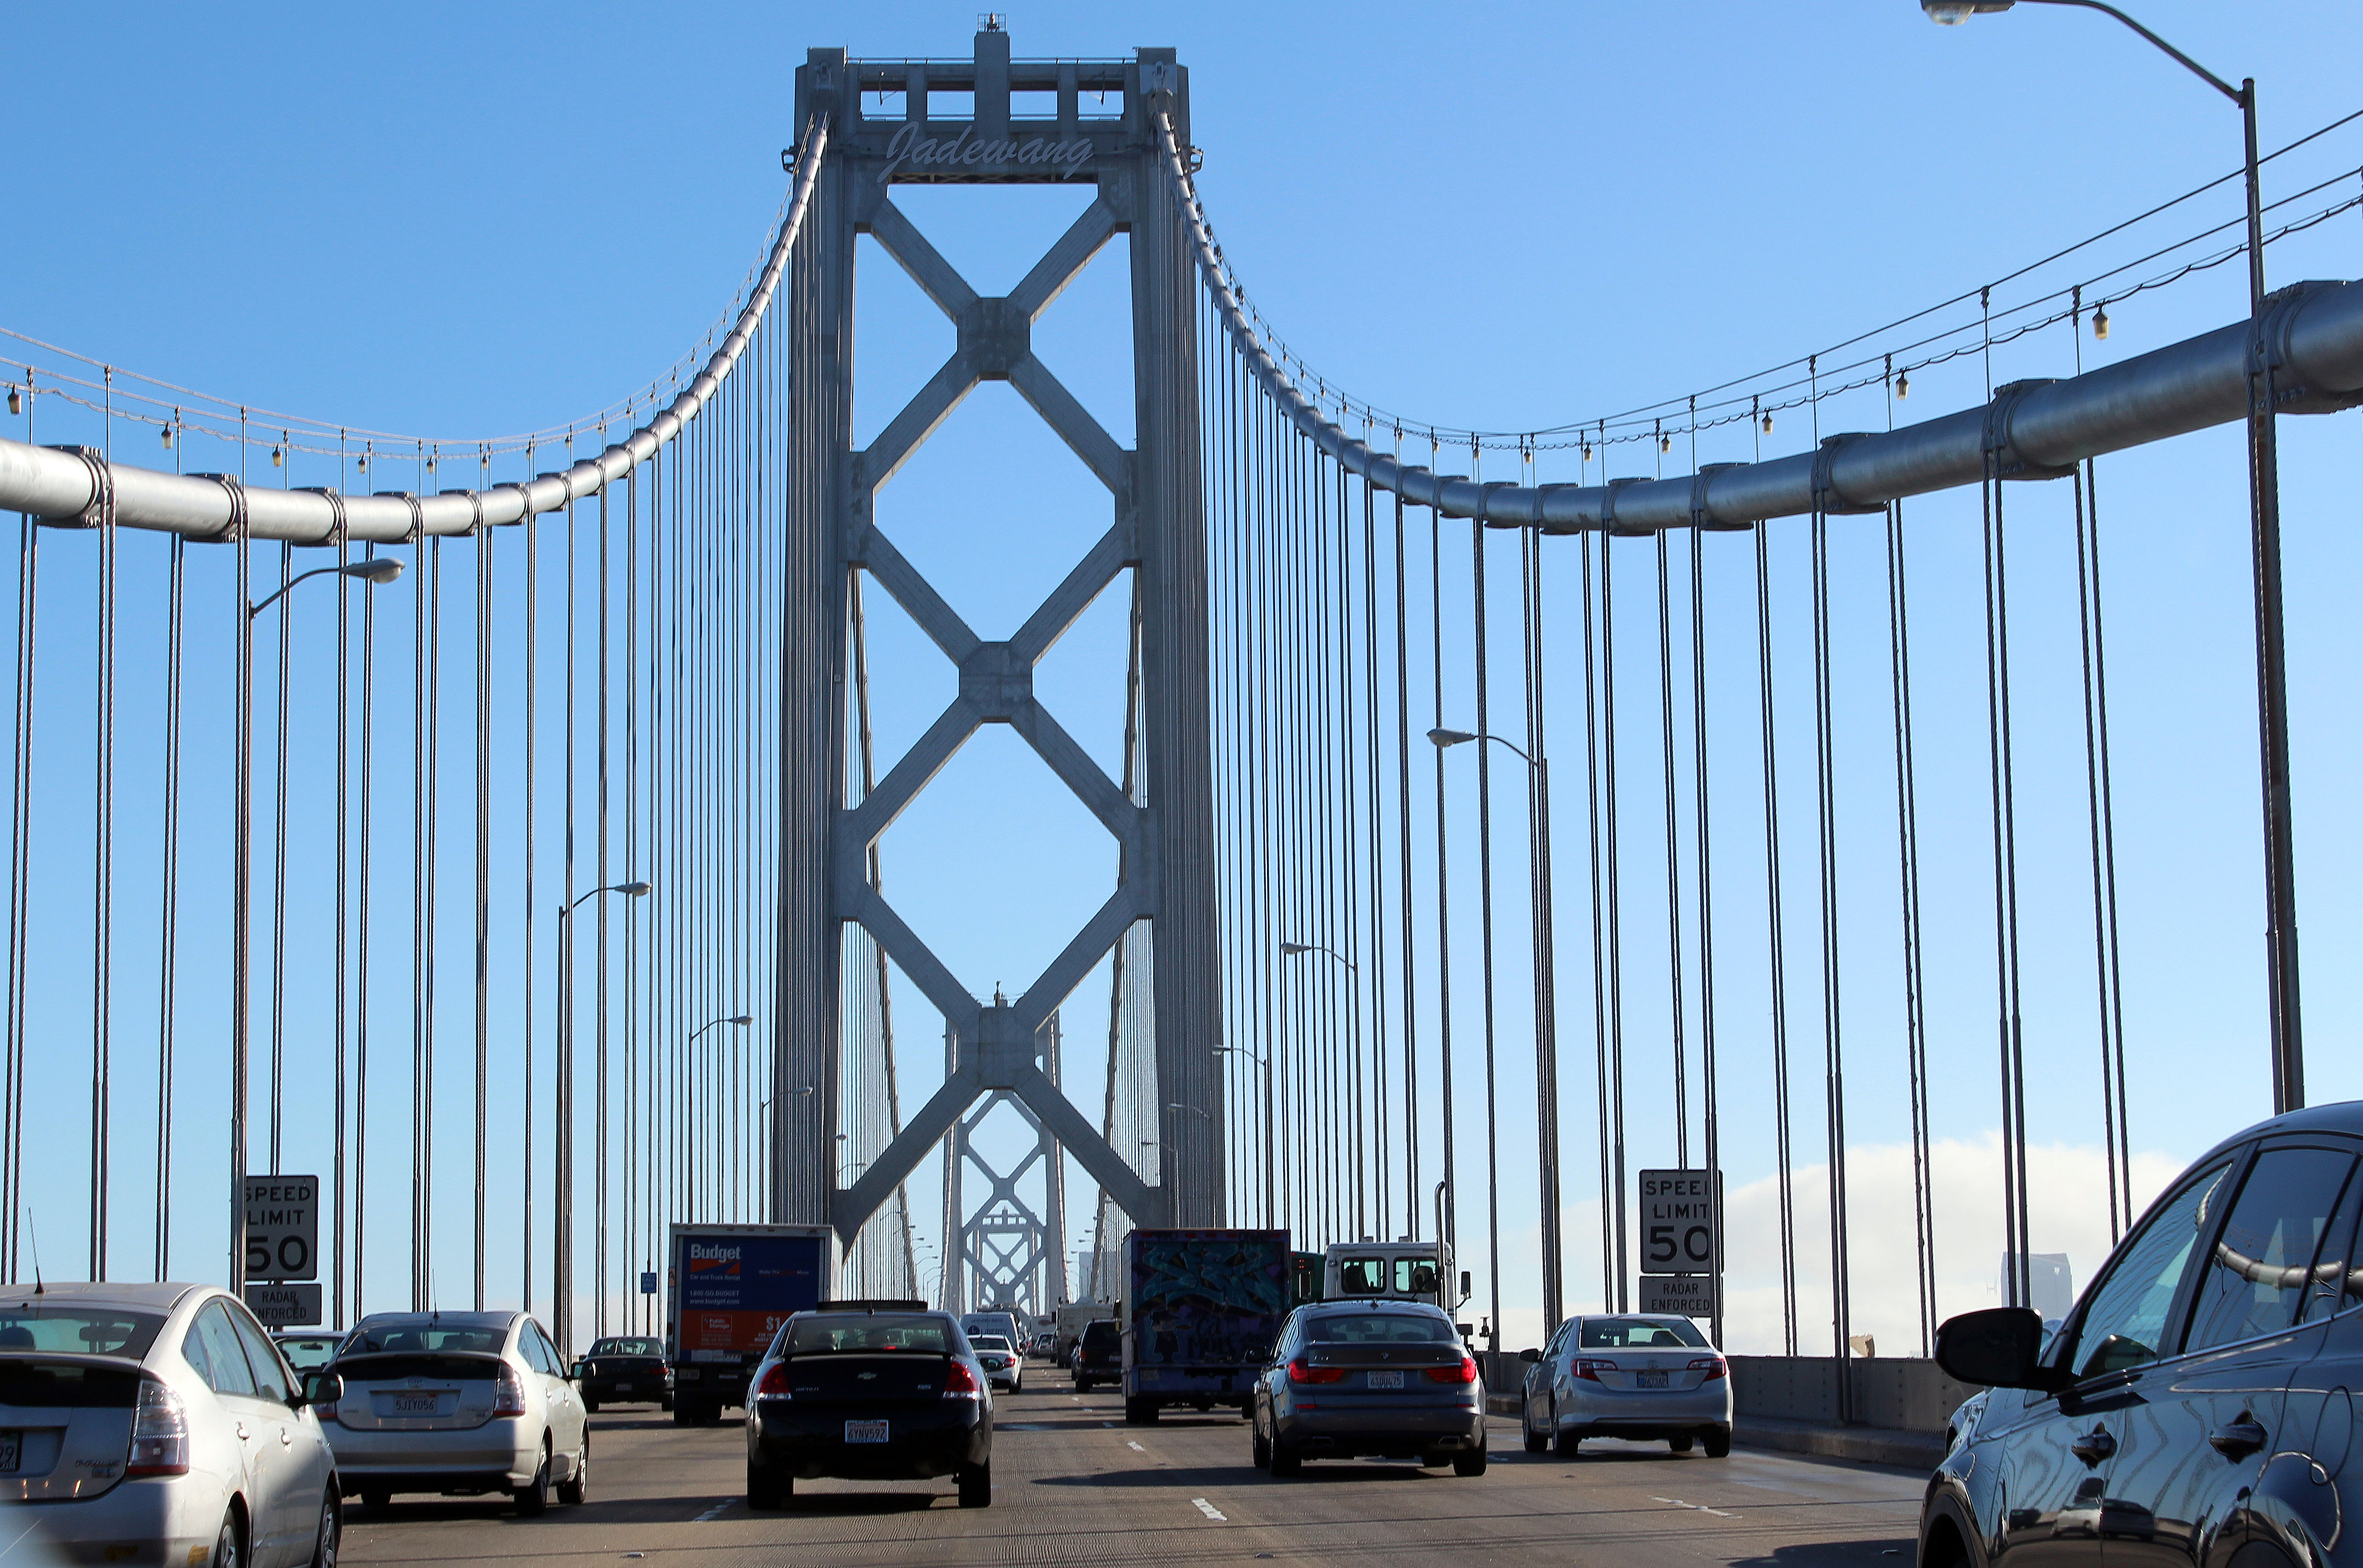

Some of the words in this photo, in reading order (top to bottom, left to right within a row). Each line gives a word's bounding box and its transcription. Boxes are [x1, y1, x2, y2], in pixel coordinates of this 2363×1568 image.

[1645, 1180, 1707, 1195] SPEE
[248, 1209, 304, 1226] LIMIT
[1654, 1203, 1708, 1219] LIMIT
[1649, 1226, 1709, 1262] 50
[246, 1235, 308, 1273] 50
[691, 1244, 741, 1263] Budget
[1663, 1283, 1699, 1295] RADAR
[262, 1291, 297, 1304] RADAR
[1651, 1299, 1710, 1311] ENFORCED
